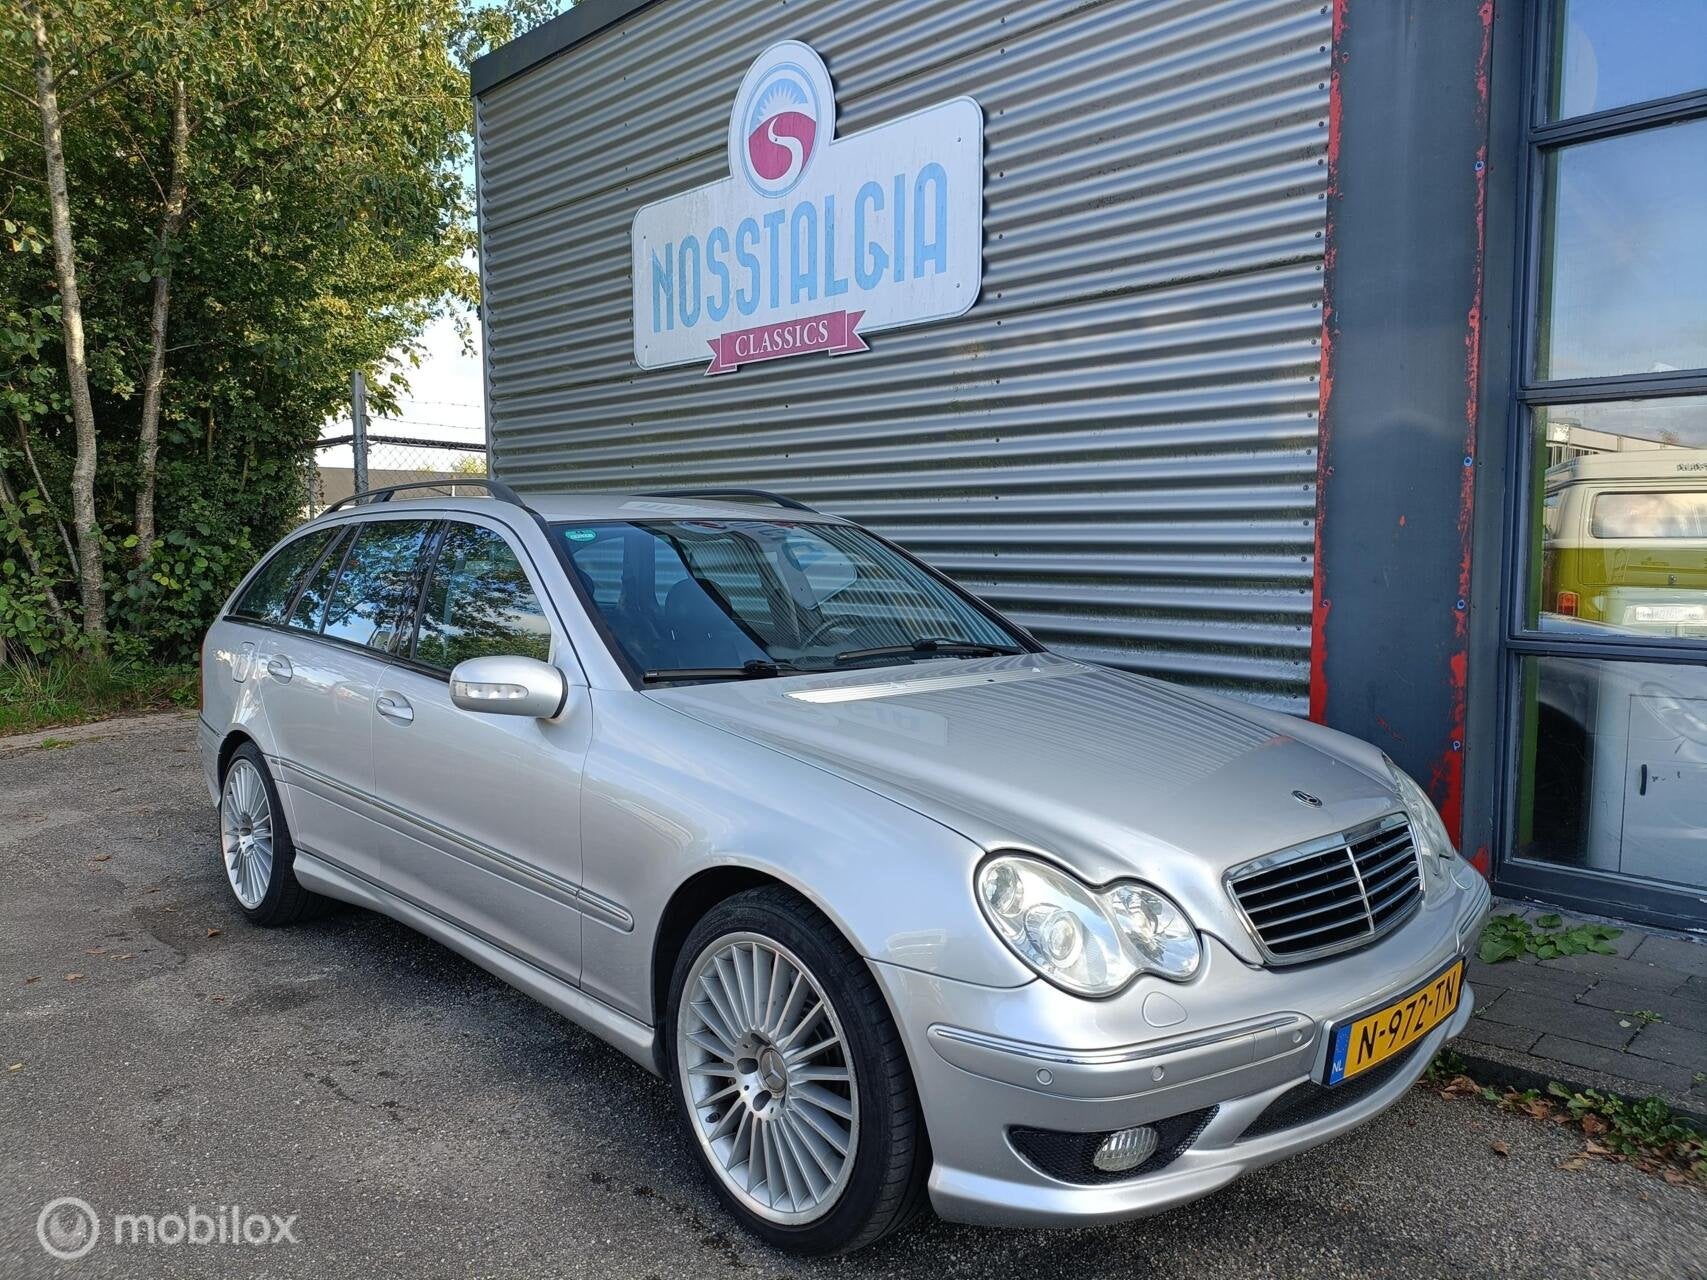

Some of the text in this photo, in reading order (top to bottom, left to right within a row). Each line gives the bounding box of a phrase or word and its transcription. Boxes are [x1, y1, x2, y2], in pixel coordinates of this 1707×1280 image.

[651, 162, 948, 333] NOSSTALGIA
[735, 320, 829, 357] CLASSICS
[1357, 971, 1457, 1065] N-972-TN
[1332, 1060, 1344, 1074] NL
